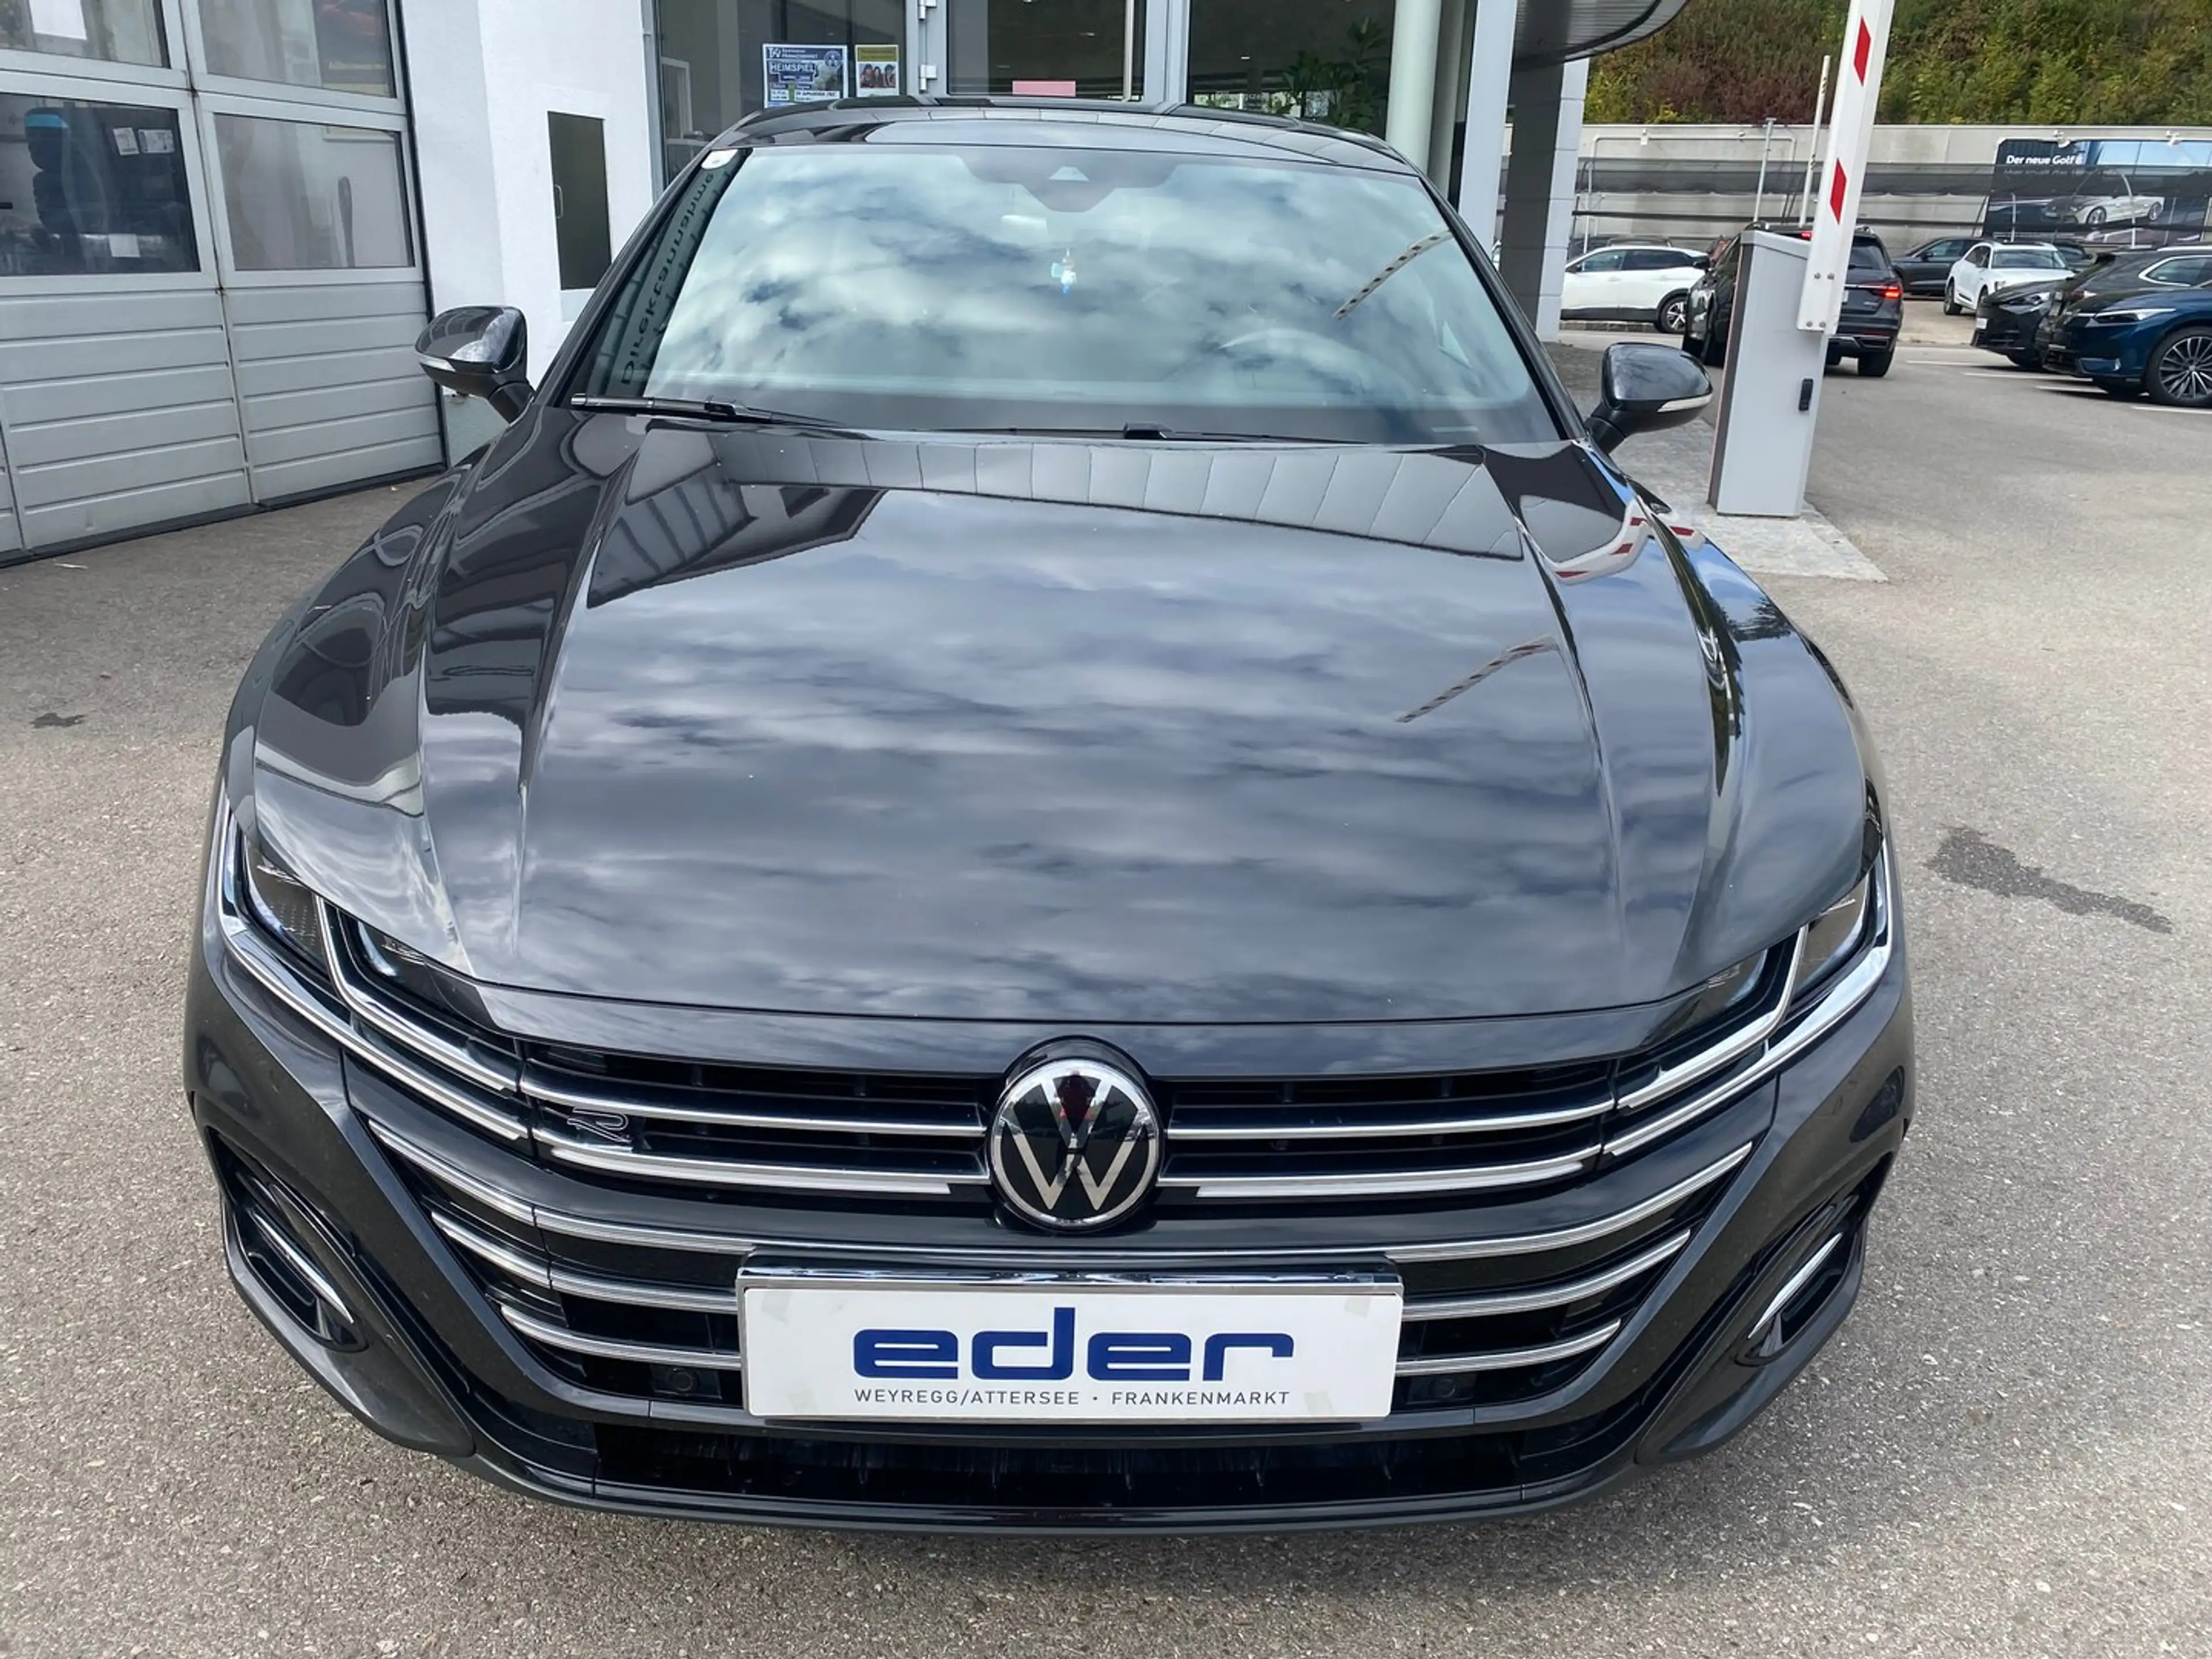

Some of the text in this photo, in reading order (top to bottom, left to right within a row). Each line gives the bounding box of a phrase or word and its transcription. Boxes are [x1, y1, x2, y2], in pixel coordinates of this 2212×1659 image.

[770, 62, 816, 72] HEIMSPIEL
[2006, 154, 2025, 164] Der
[2052, 154, 2075, 165] Golf
[853, 1306, 1295, 1382] eder
[854, 1388, 1290, 1406] WEYREGG/ATTERSEE FRANKENMARKT
